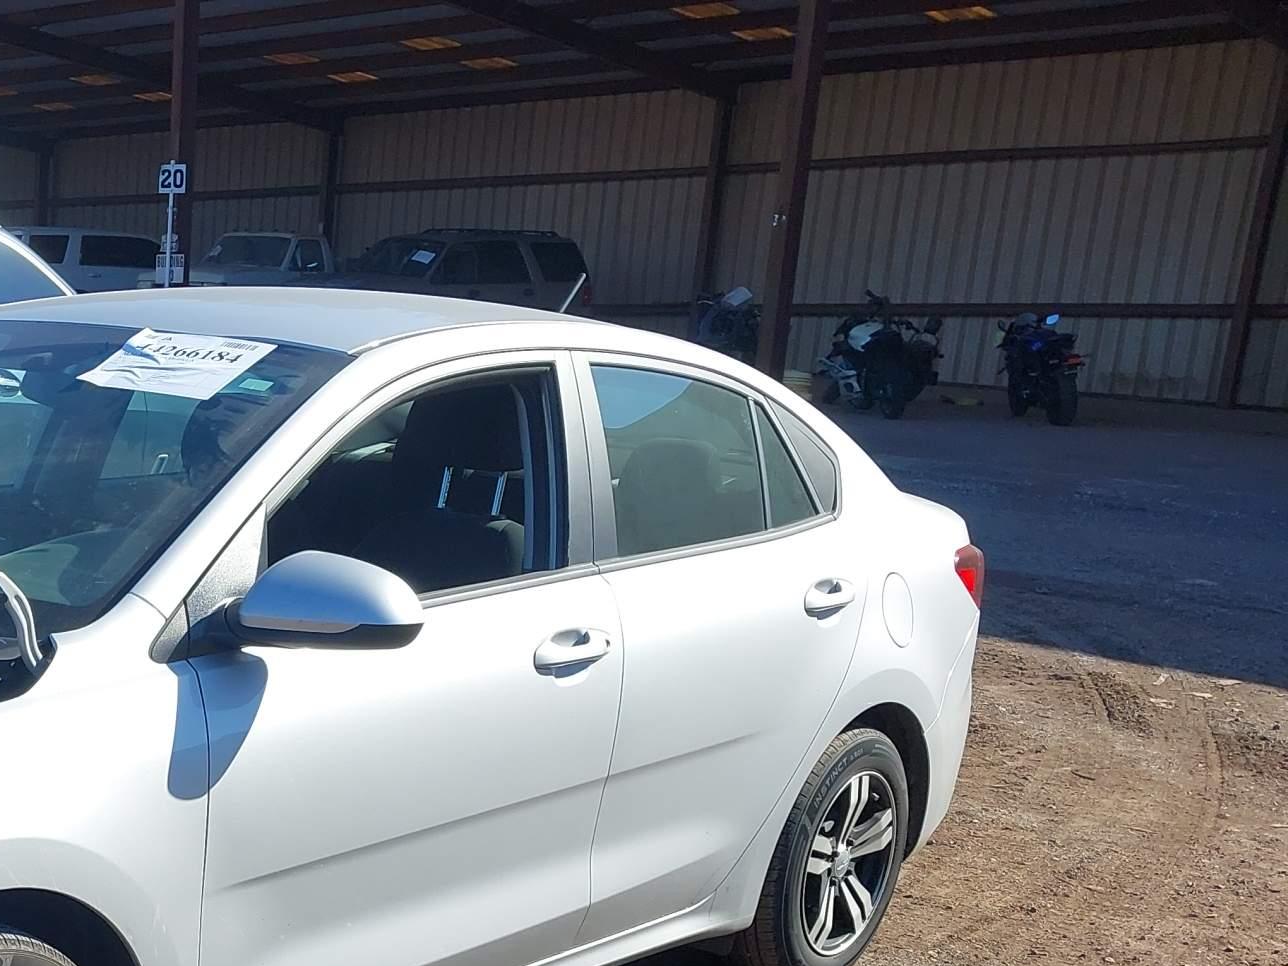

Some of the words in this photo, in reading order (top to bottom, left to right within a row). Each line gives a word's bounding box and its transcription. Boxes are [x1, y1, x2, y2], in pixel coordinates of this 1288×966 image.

[161, 169, 184, 188] 20
[157, 255, 184, 268] BUIDING
[136, 342, 244, 364] 44266184
[813, 756, 848, 809] INSTINCT
